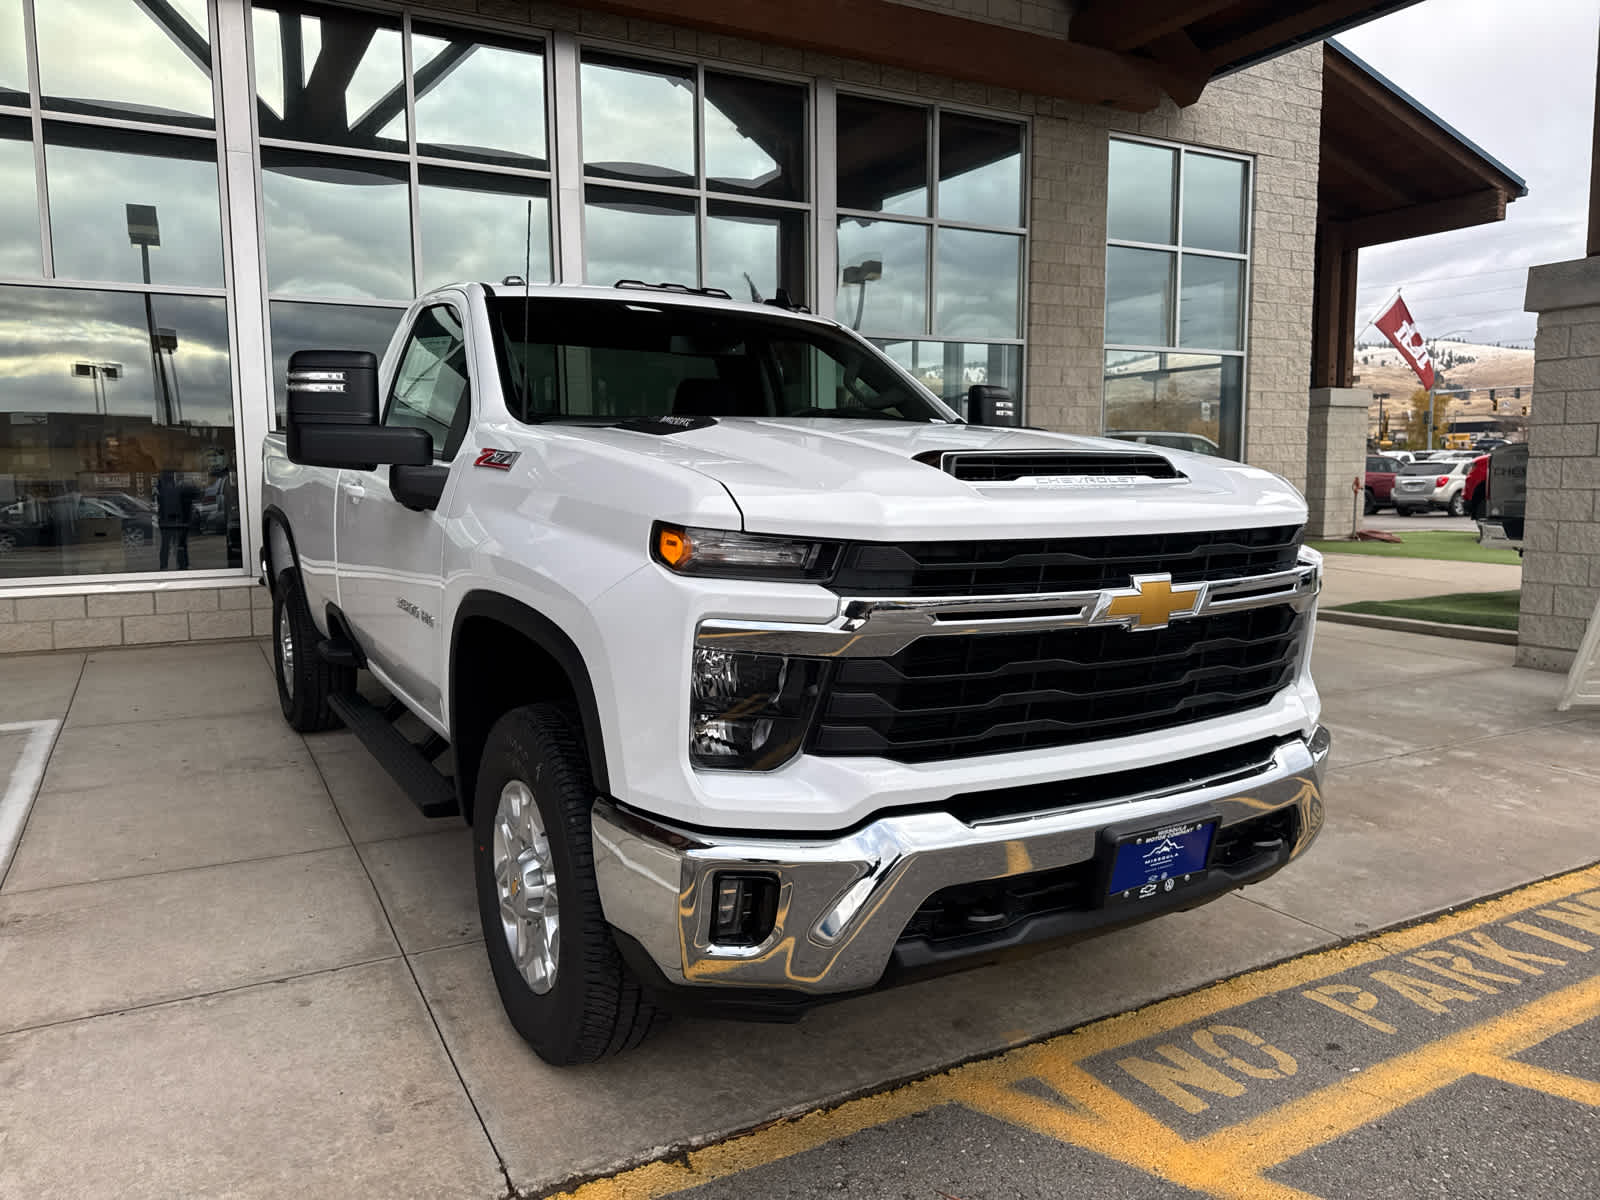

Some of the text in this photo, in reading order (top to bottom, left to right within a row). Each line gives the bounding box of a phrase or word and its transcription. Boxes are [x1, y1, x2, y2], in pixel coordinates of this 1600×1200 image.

[473, 448, 521, 471] Z71
[1035, 476, 1137, 485] CHEVROLET
[1116, 1024, 1298, 1115] NO
